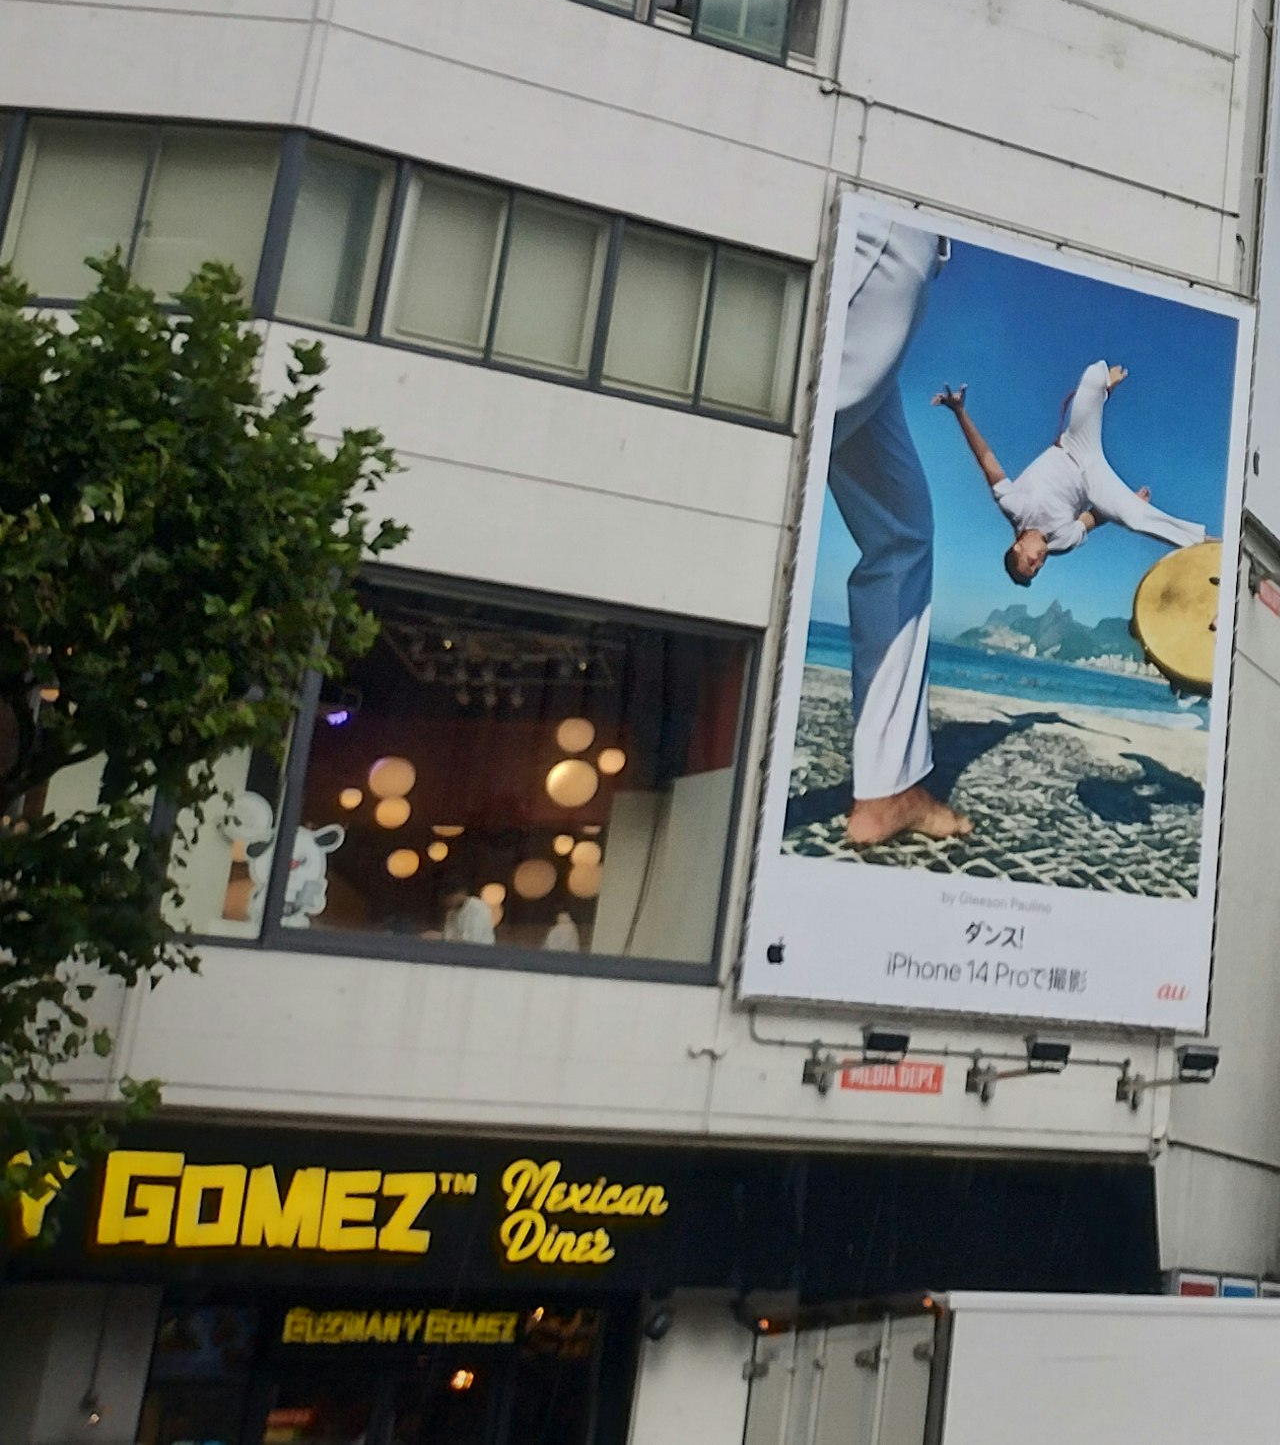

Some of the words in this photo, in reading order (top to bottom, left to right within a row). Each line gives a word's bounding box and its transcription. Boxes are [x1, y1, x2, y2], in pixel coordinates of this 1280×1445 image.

[965, 921, 1025, 950] ダンス!
[886, 952, 962, 983] iPhone
[967, 959, 989, 985] 14
[1156, 982, 1191, 1002] au
[98, 1150, 437, 1253] GOMEZ
[502, 1159, 669, 1217] Mexican
[500, 1217, 615, 1265] Diner
